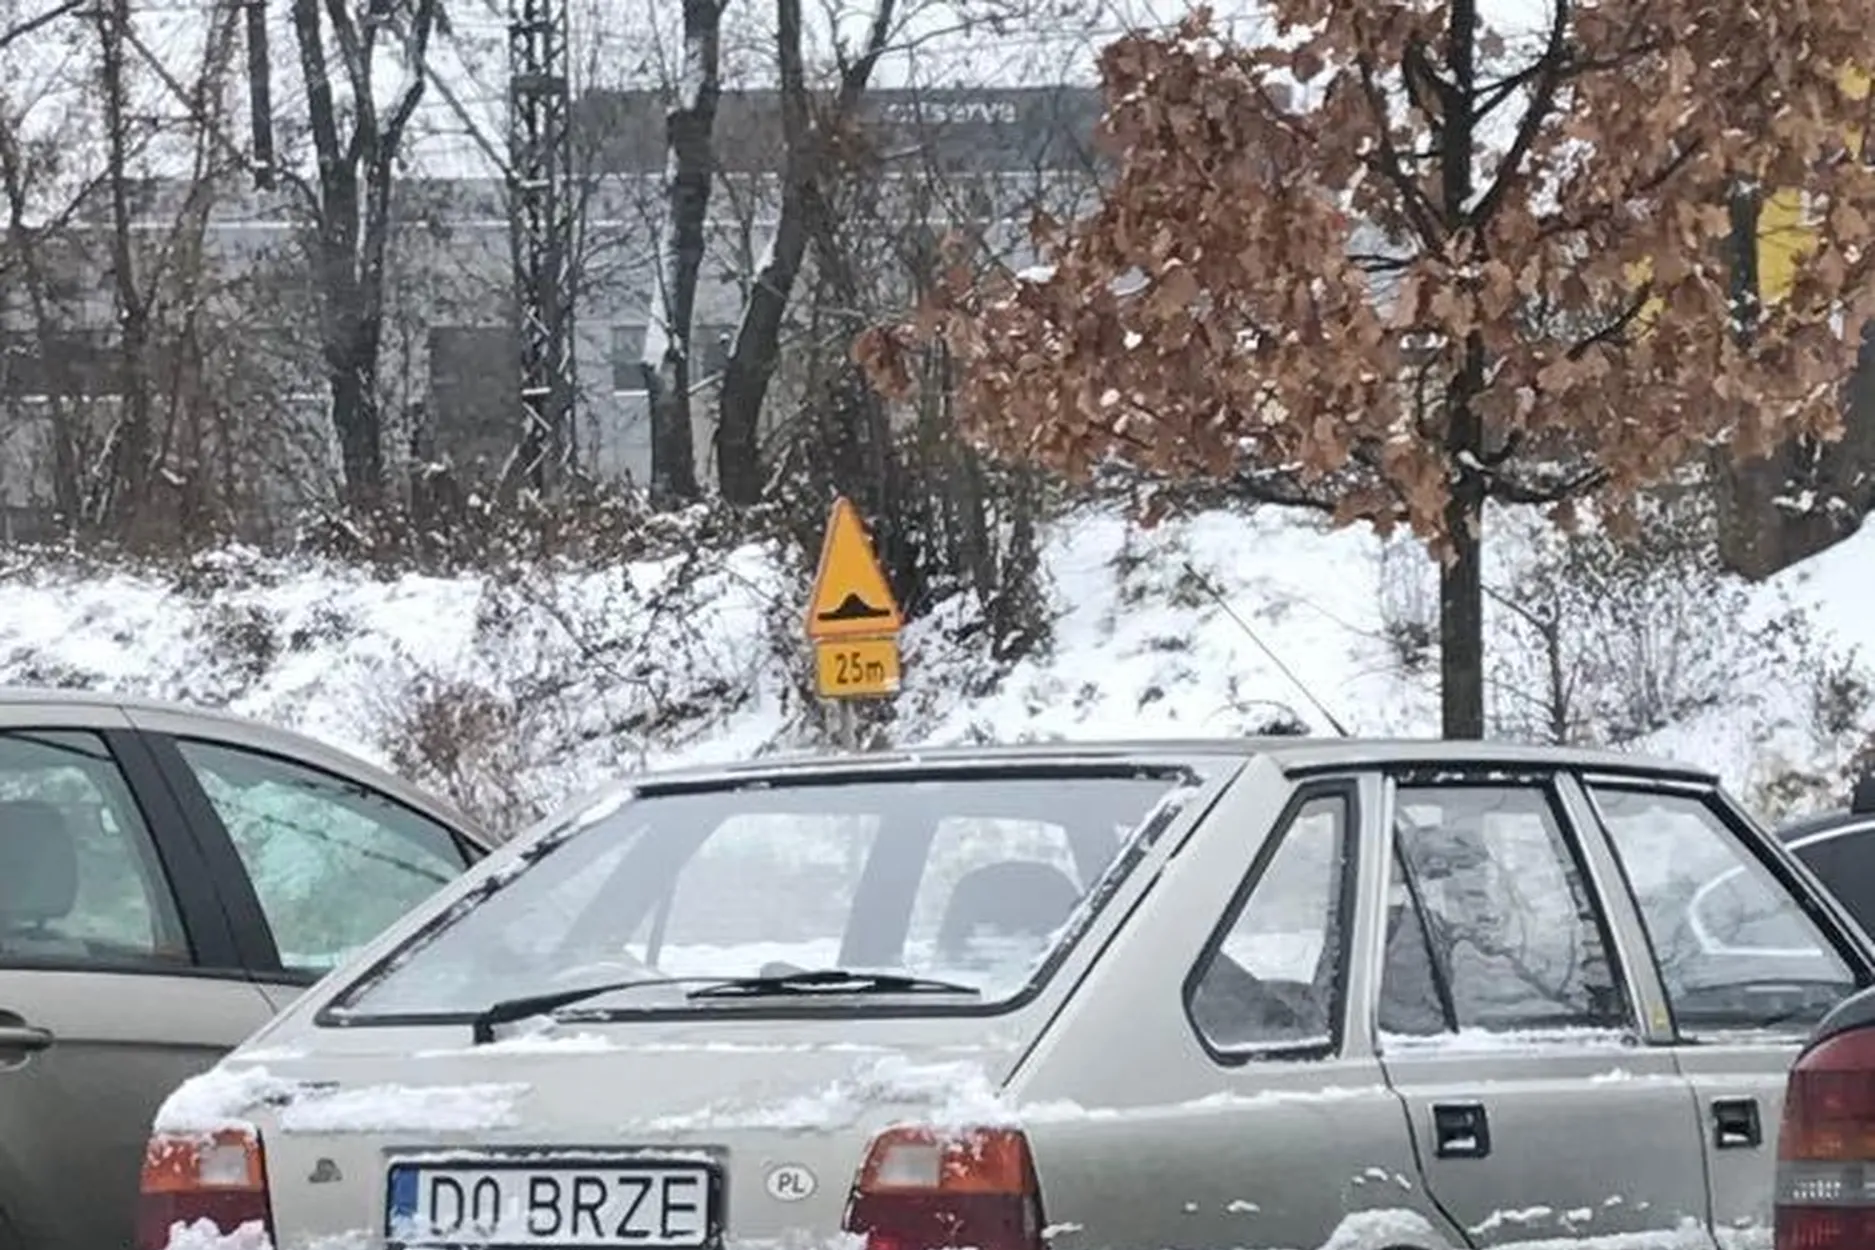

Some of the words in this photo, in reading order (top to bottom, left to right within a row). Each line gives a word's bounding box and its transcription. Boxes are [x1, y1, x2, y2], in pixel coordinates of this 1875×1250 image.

[835, 651, 885, 684] 25m
[778, 1172, 805, 1193] PL
[527, 1175, 698, 1239] BRZE
